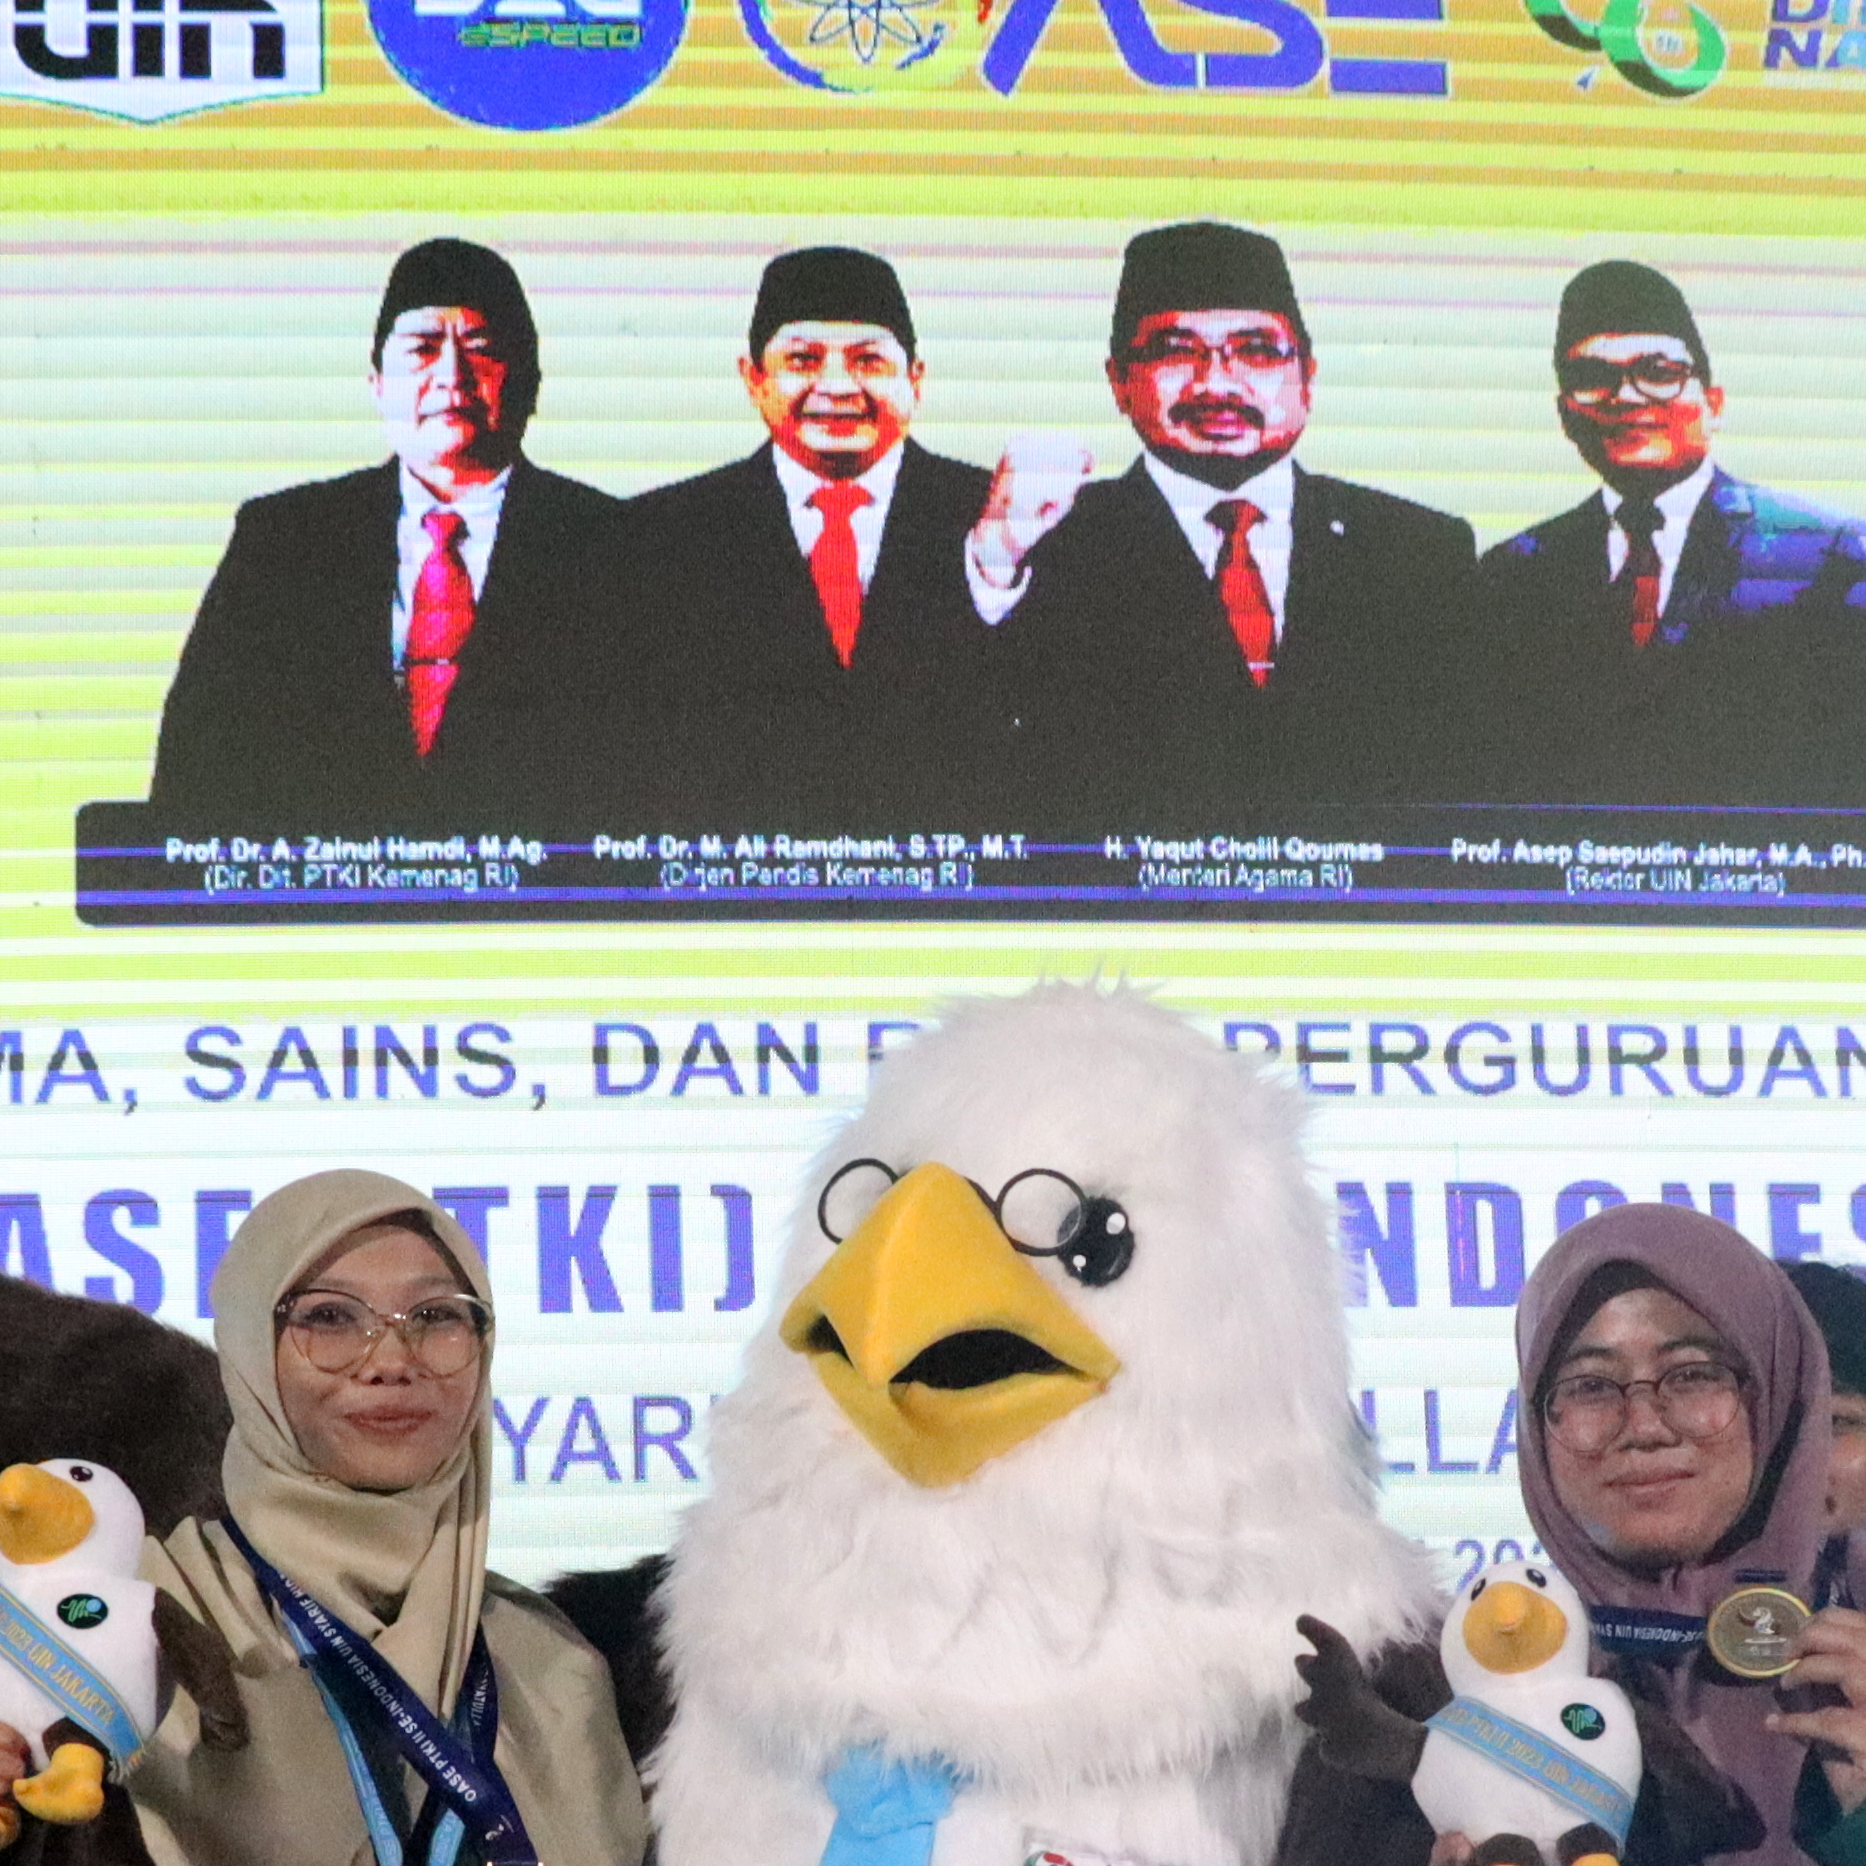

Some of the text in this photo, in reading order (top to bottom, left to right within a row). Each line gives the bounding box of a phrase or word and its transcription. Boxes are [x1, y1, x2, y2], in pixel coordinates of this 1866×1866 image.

[165, 836, 227, 862] Prof.
[231, 837, 263, 862] Dr.
[272, 837, 296, 862] A.
[303, 836, 380, 862] Zainul
[477, 836, 549, 865] M.Ag.
[591, 834, 653, 861] Prof.
[658, 835, 692, 861] Dr.
[699, 835, 727, 861] M.
[734, 835, 766, 860] Ali
[980, 834, 1030, 860] M.T.
[1104, 836, 1131, 859] H.
[1135, 835, 1205, 863] Yaqut
[1283, 836, 1385, 862] Qoumas
[1450, 838, 1507, 862] Prof.
[1512, 839, 1573, 868] Asep
[1576, 839, 1686, 868] Saepudin
[1691, 840, 1763, 868] Jahar,
[304, 864, 361, 889] PTKI
[367, 863, 478, 894] Kemenag
[484, 863, 520, 893] RI)
[824, 862, 934, 892] Kemenag
[1234, 863, 1314, 893] Agama
[1319, 863, 1354, 893] RI)
[1648, 868, 1692, 891] UIN
[183, 1021, 547, 1111] SAINS,
[591, 1020, 820, 1098] DAN
[432, 1185, 754, 1313] TKI)
[298, 1596, 337, 1638] SYARIF
[1614, 1624, 1632, 1638] UIN
[330, 1635, 353, 1658] UIN
[28, 1642, 57, 1671] UIN
[49, 1663, 115, 1725] JAKARTA
[347, 1654, 418, 1735] SE-INDONESIA
[419, 1741, 448, 1769] PTKI
[442, 1765, 477, 1802] OASE
